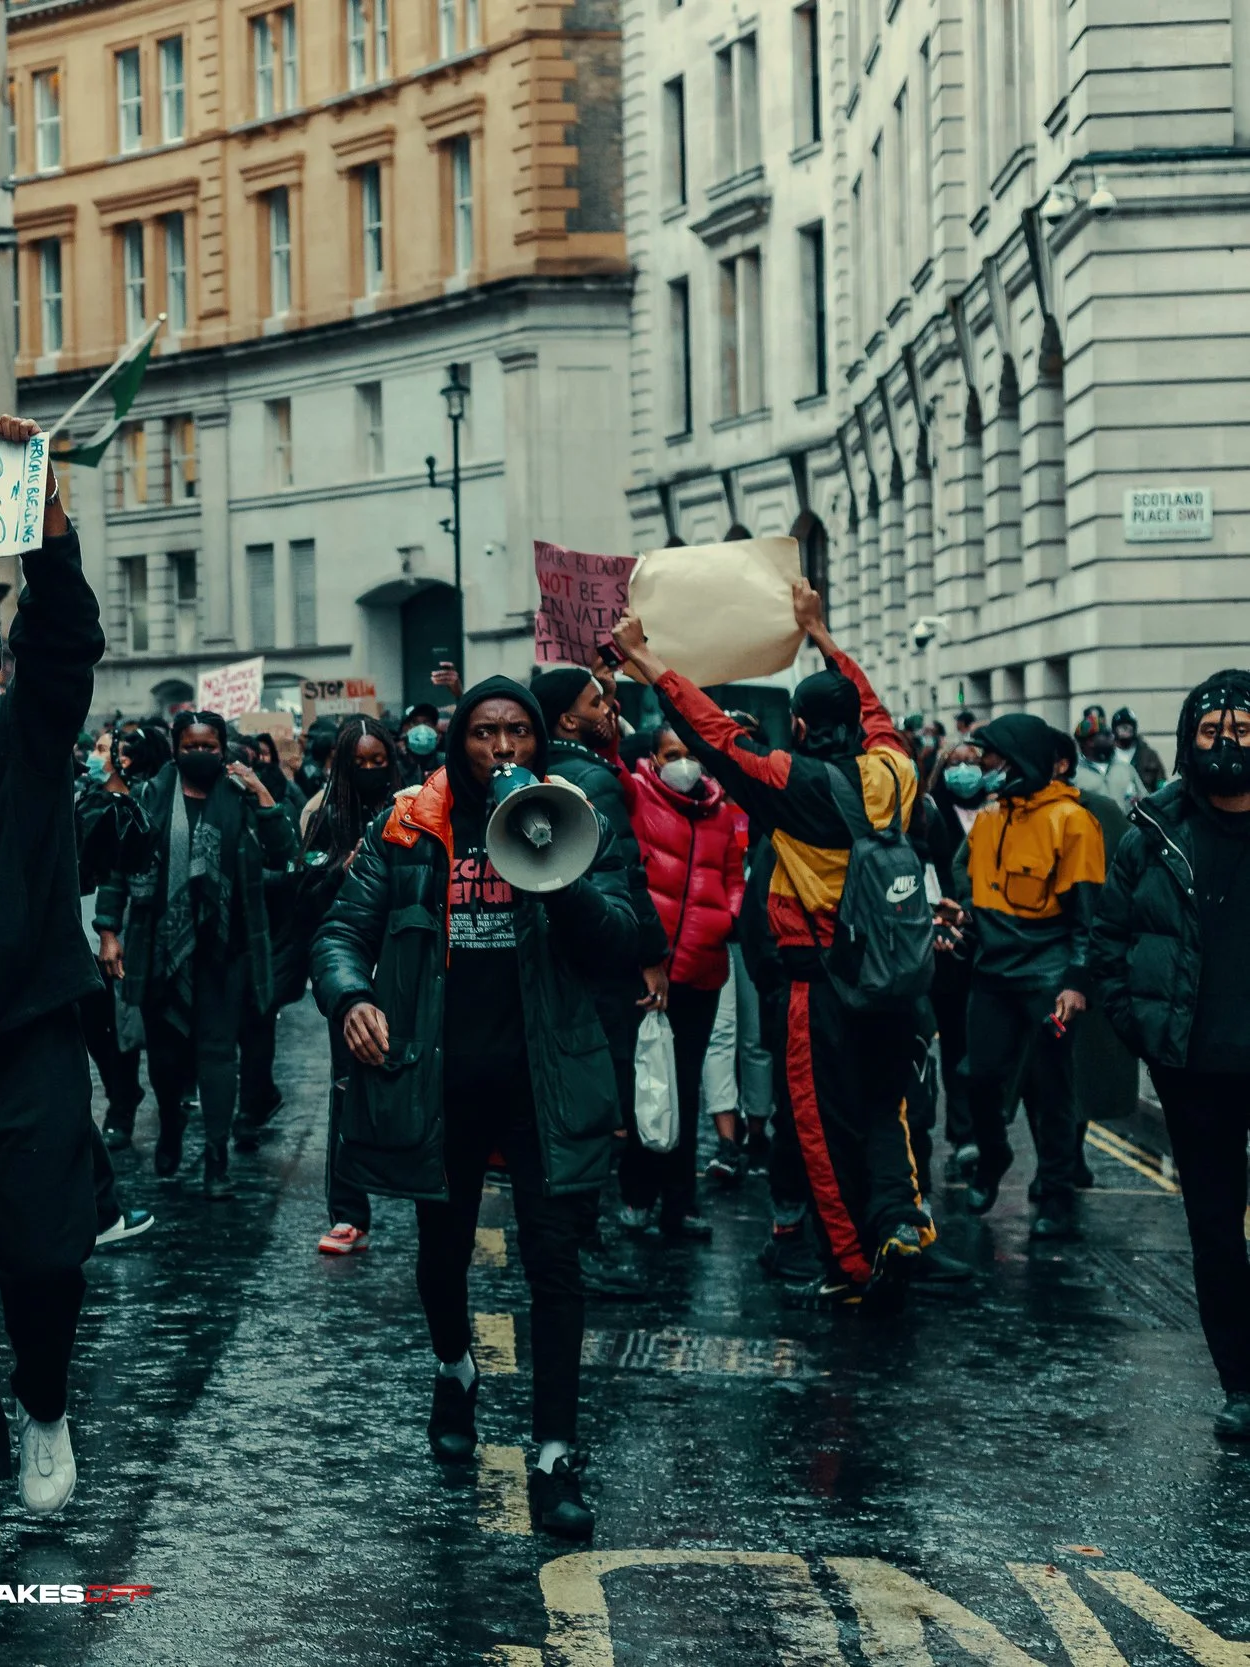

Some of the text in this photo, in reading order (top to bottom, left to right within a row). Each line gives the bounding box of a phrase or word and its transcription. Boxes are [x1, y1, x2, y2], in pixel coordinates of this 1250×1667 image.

[28, 438, 45, 473] AFRICA
[1133, 491, 1204, 507] SCOTLAND
[1133, 508, 1204, 523] PLACE SW1
[538, 544, 627, 577] YOUR BLOOD
[539, 571, 573, 598] NOT
[580, 582, 604, 604] BE
[540, 595, 623, 629] IN VAIN
[304, 680, 345, 700] STOP
[893, 875, 916, 892] NIKE
